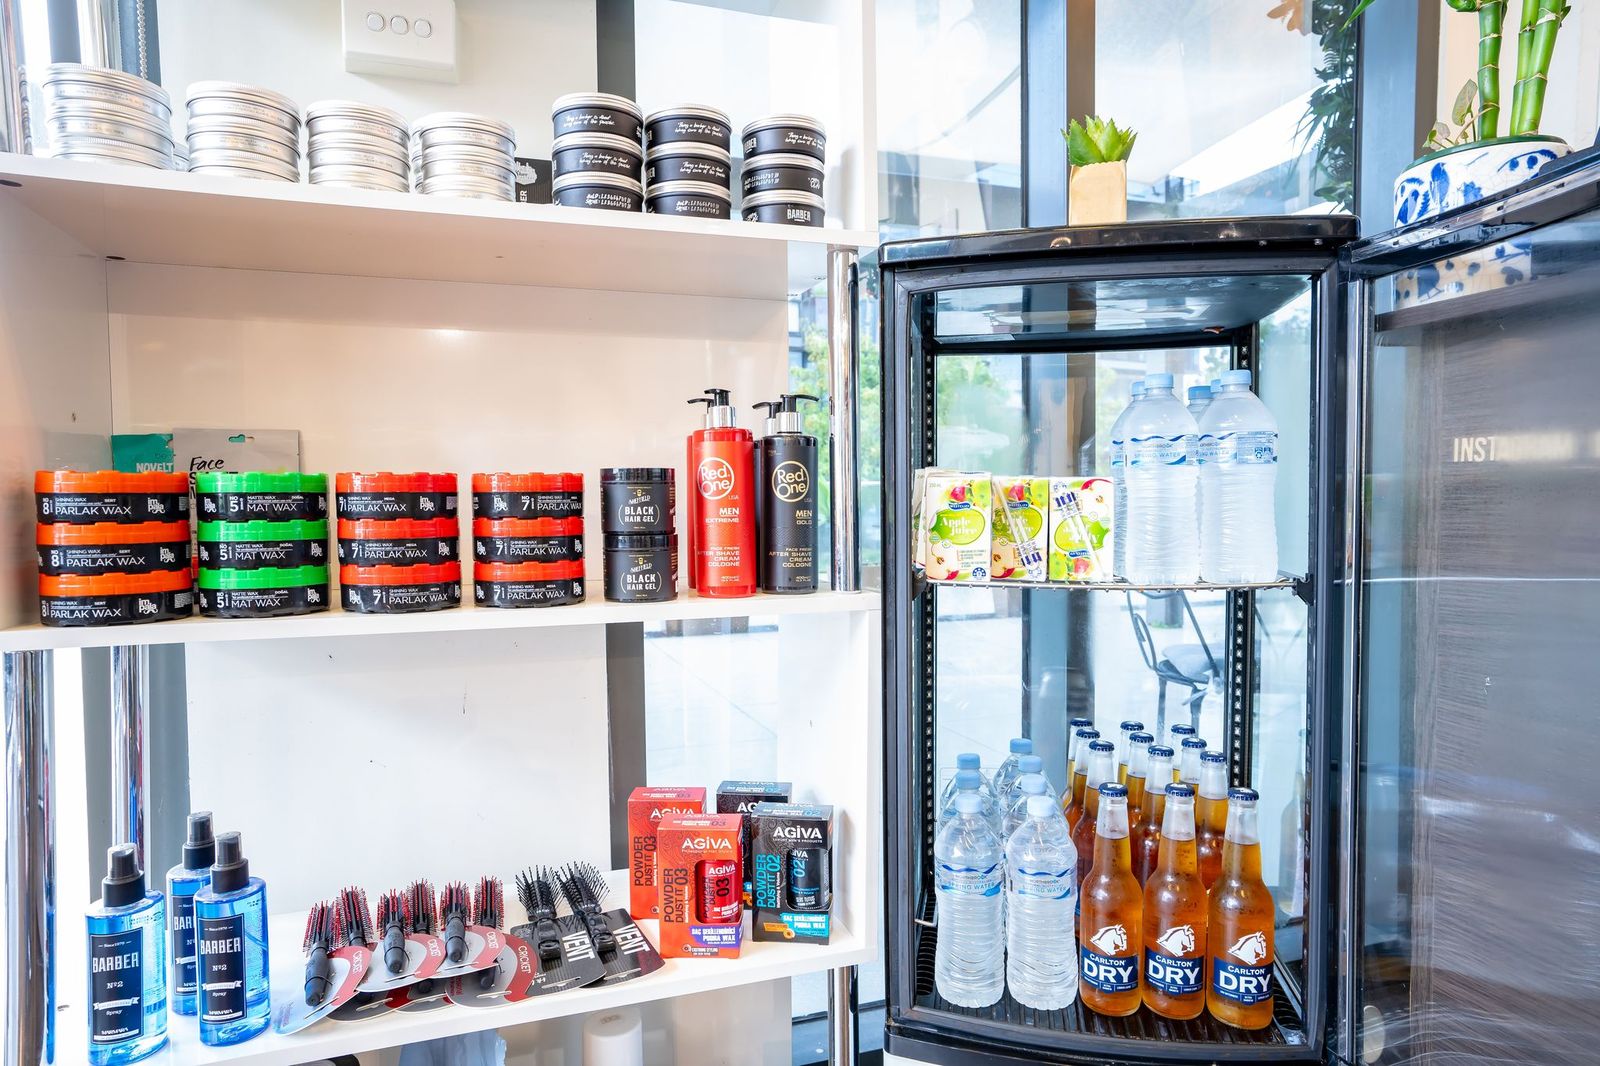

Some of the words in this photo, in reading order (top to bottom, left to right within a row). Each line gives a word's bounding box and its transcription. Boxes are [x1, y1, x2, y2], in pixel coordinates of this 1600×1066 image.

[787, 208, 810, 221] BARBER
[190, 457, 224, 471] Face
[701, 465, 727, 480] Red
[777, 470, 804, 483] Red
[701, 479, 730, 496] One
[777, 483, 806, 498] One
[43, 502, 49, 514] 8
[55, 507, 100, 515] PARLAK
[102, 506, 131, 514] WAX
[229, 501, 238, 512] 5
[522, 500, 529, 510] 7
[940, 517, 970, 527] Apple
[220, 549, 228, 560] 5
[236, 552, 257, 560] MAT
[352, 548, 358, 558] 7
[496, 545, 504, 555] 7
[51, 555, 59, 566] 8
[67, 558, 113, 566] PARLAK
[627, 574, 656, 582] BLACK
[374, 594, 381, 604] 7
[389, 596, 427, 604] PARLAK
[494, 590, 501, 600] 7
[217, 597, 224, 608] 5
[232, 600, 252, 608] MAT
[255, 599, 280, 607] WAX
[51, 610, 89, 618] PARLAK
[92, 609, 121, 617] WAX
[644, 836, 656, 851] 03
[634, 836, 644, 886] POWDER
[767, 855, 780, 872] 02
[794, 860, 805, 877] 02
[674, 868, 688, 885] 03
[756, 854, 766, 907] POWDER
[767, 873, 775, 881] IT
[716, 878, 729, 897] 03
[664, 868, 674, 922] POWDER
[675, 900, 684, 922] DUST
[201, 937, 241, 955] BARBER
[613, 924, 650, 955] VENT
[562, 931, 596, 962] VENT
[93, 952, 139, 973] BARBER
[518, 946, 531, 973] CRICKET
[1090, 954, 1125, 966] CARLTON
[1156, 955, 1192, 968] CARLTON
[1084, 958, 1134, 984] DRY
[1148, 961, 1200, 985] DRY
[1228, 966, 1264, 975] CARLTON
[1219, 970, 1271, 994] DRY
